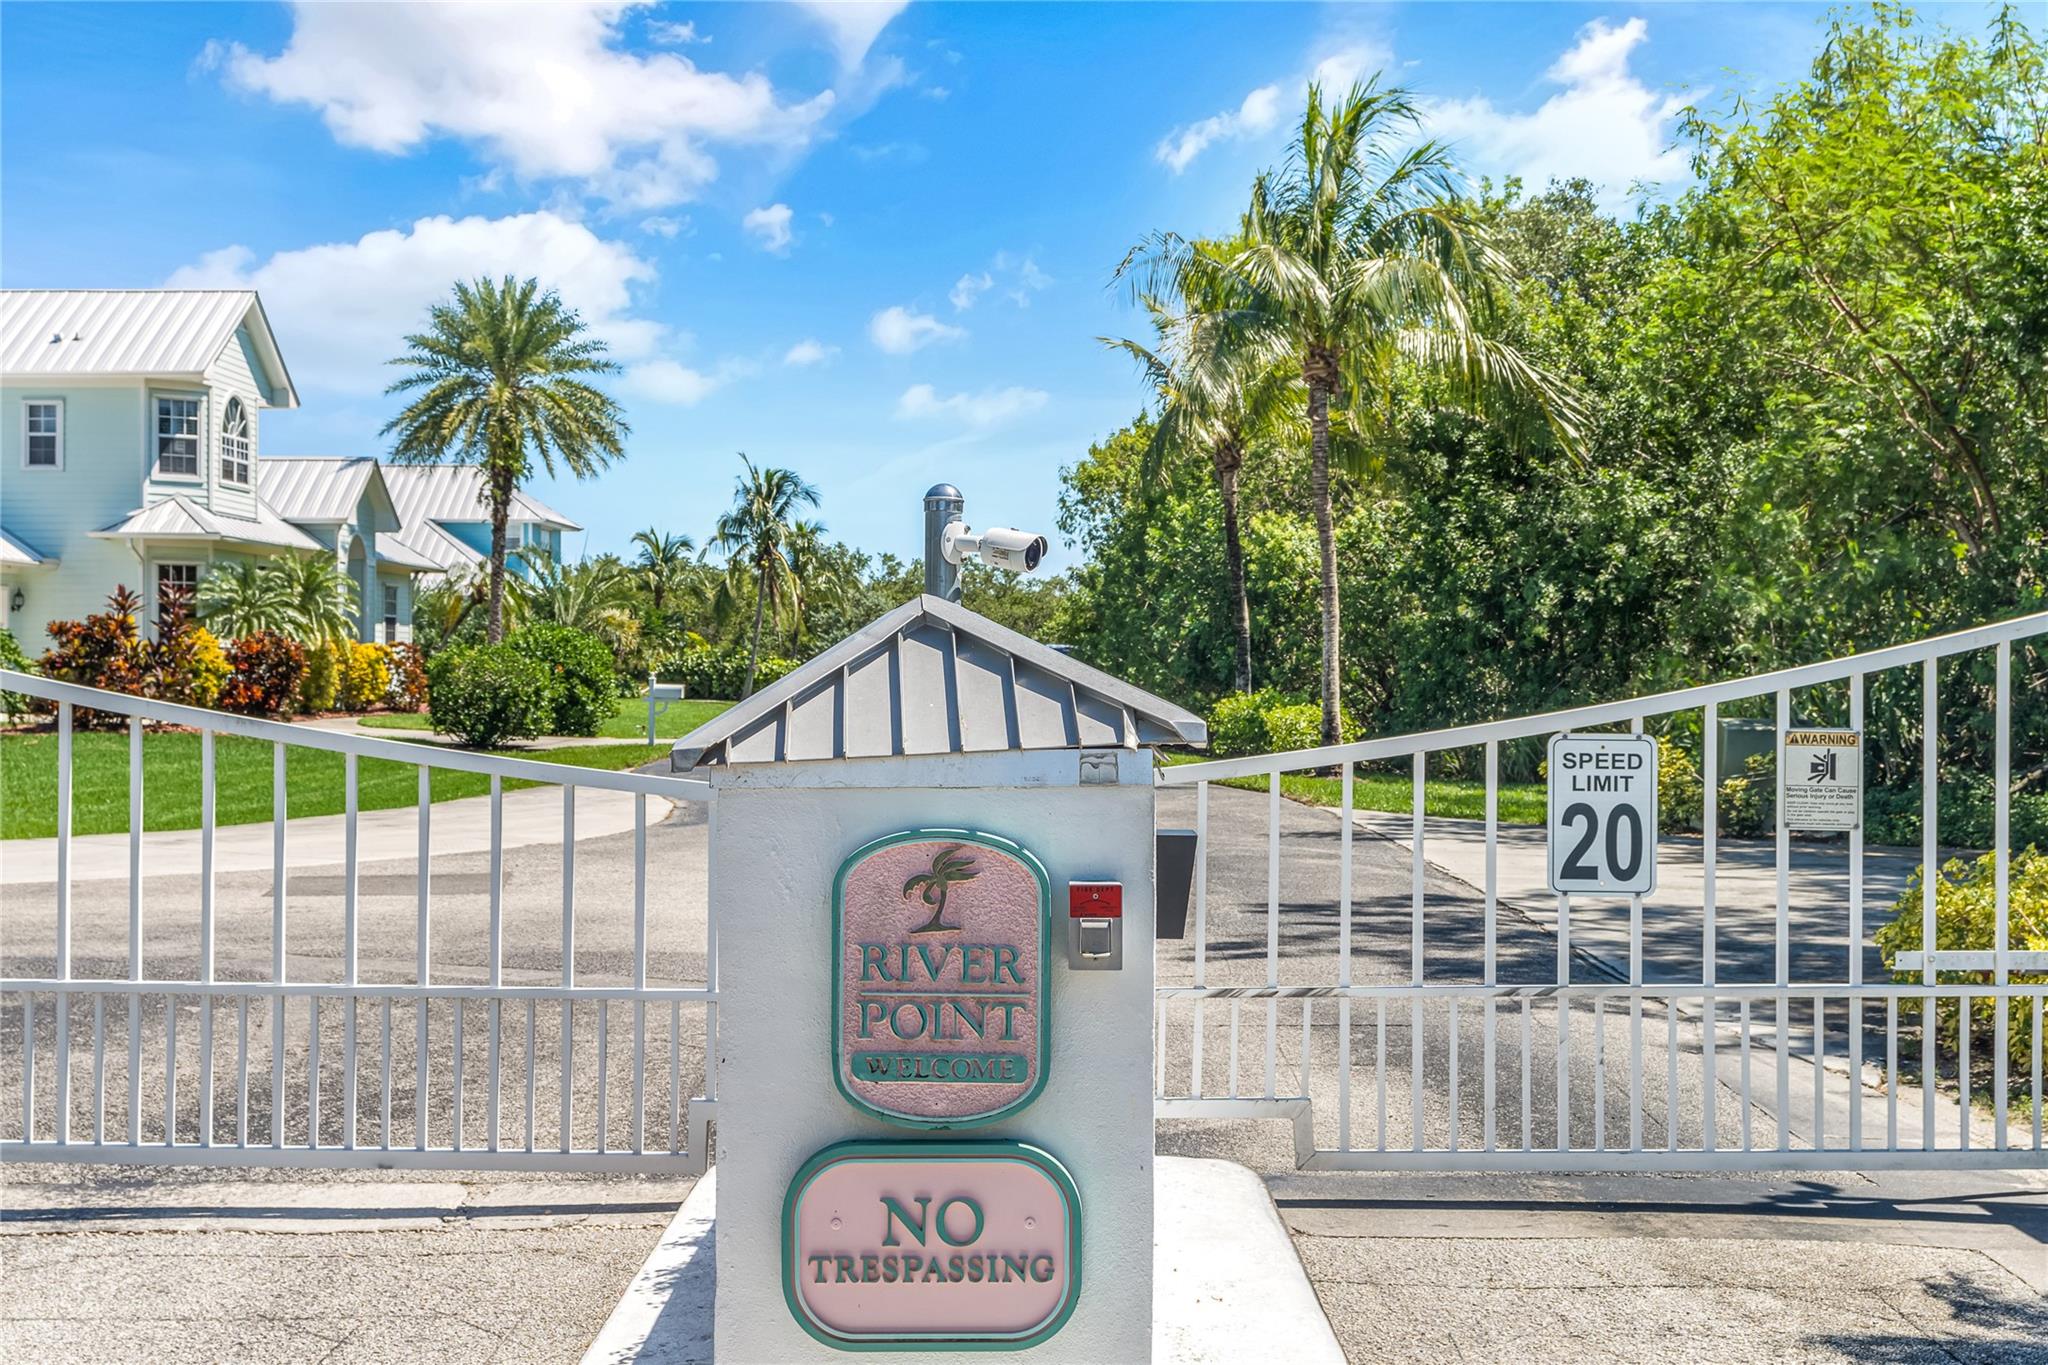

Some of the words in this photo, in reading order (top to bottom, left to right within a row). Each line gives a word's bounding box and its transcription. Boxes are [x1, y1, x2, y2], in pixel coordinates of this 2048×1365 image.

[1799, 734, 1856, 745] WARNING
[1562, 753, 1643, 770] SPEED
[1572, 775, 1634, 792] LIMIT
[1560, 802, 1643, 882] 20
[858, 943, 1026, 985] RIVER
[856, 1001, 1028, 1041] POINT
[866, 1056, 1016, 1080] WELCOME
[880, 1196, 985, 1247] NO
[808, 1255, 1056, 1284] TRESPASSING
